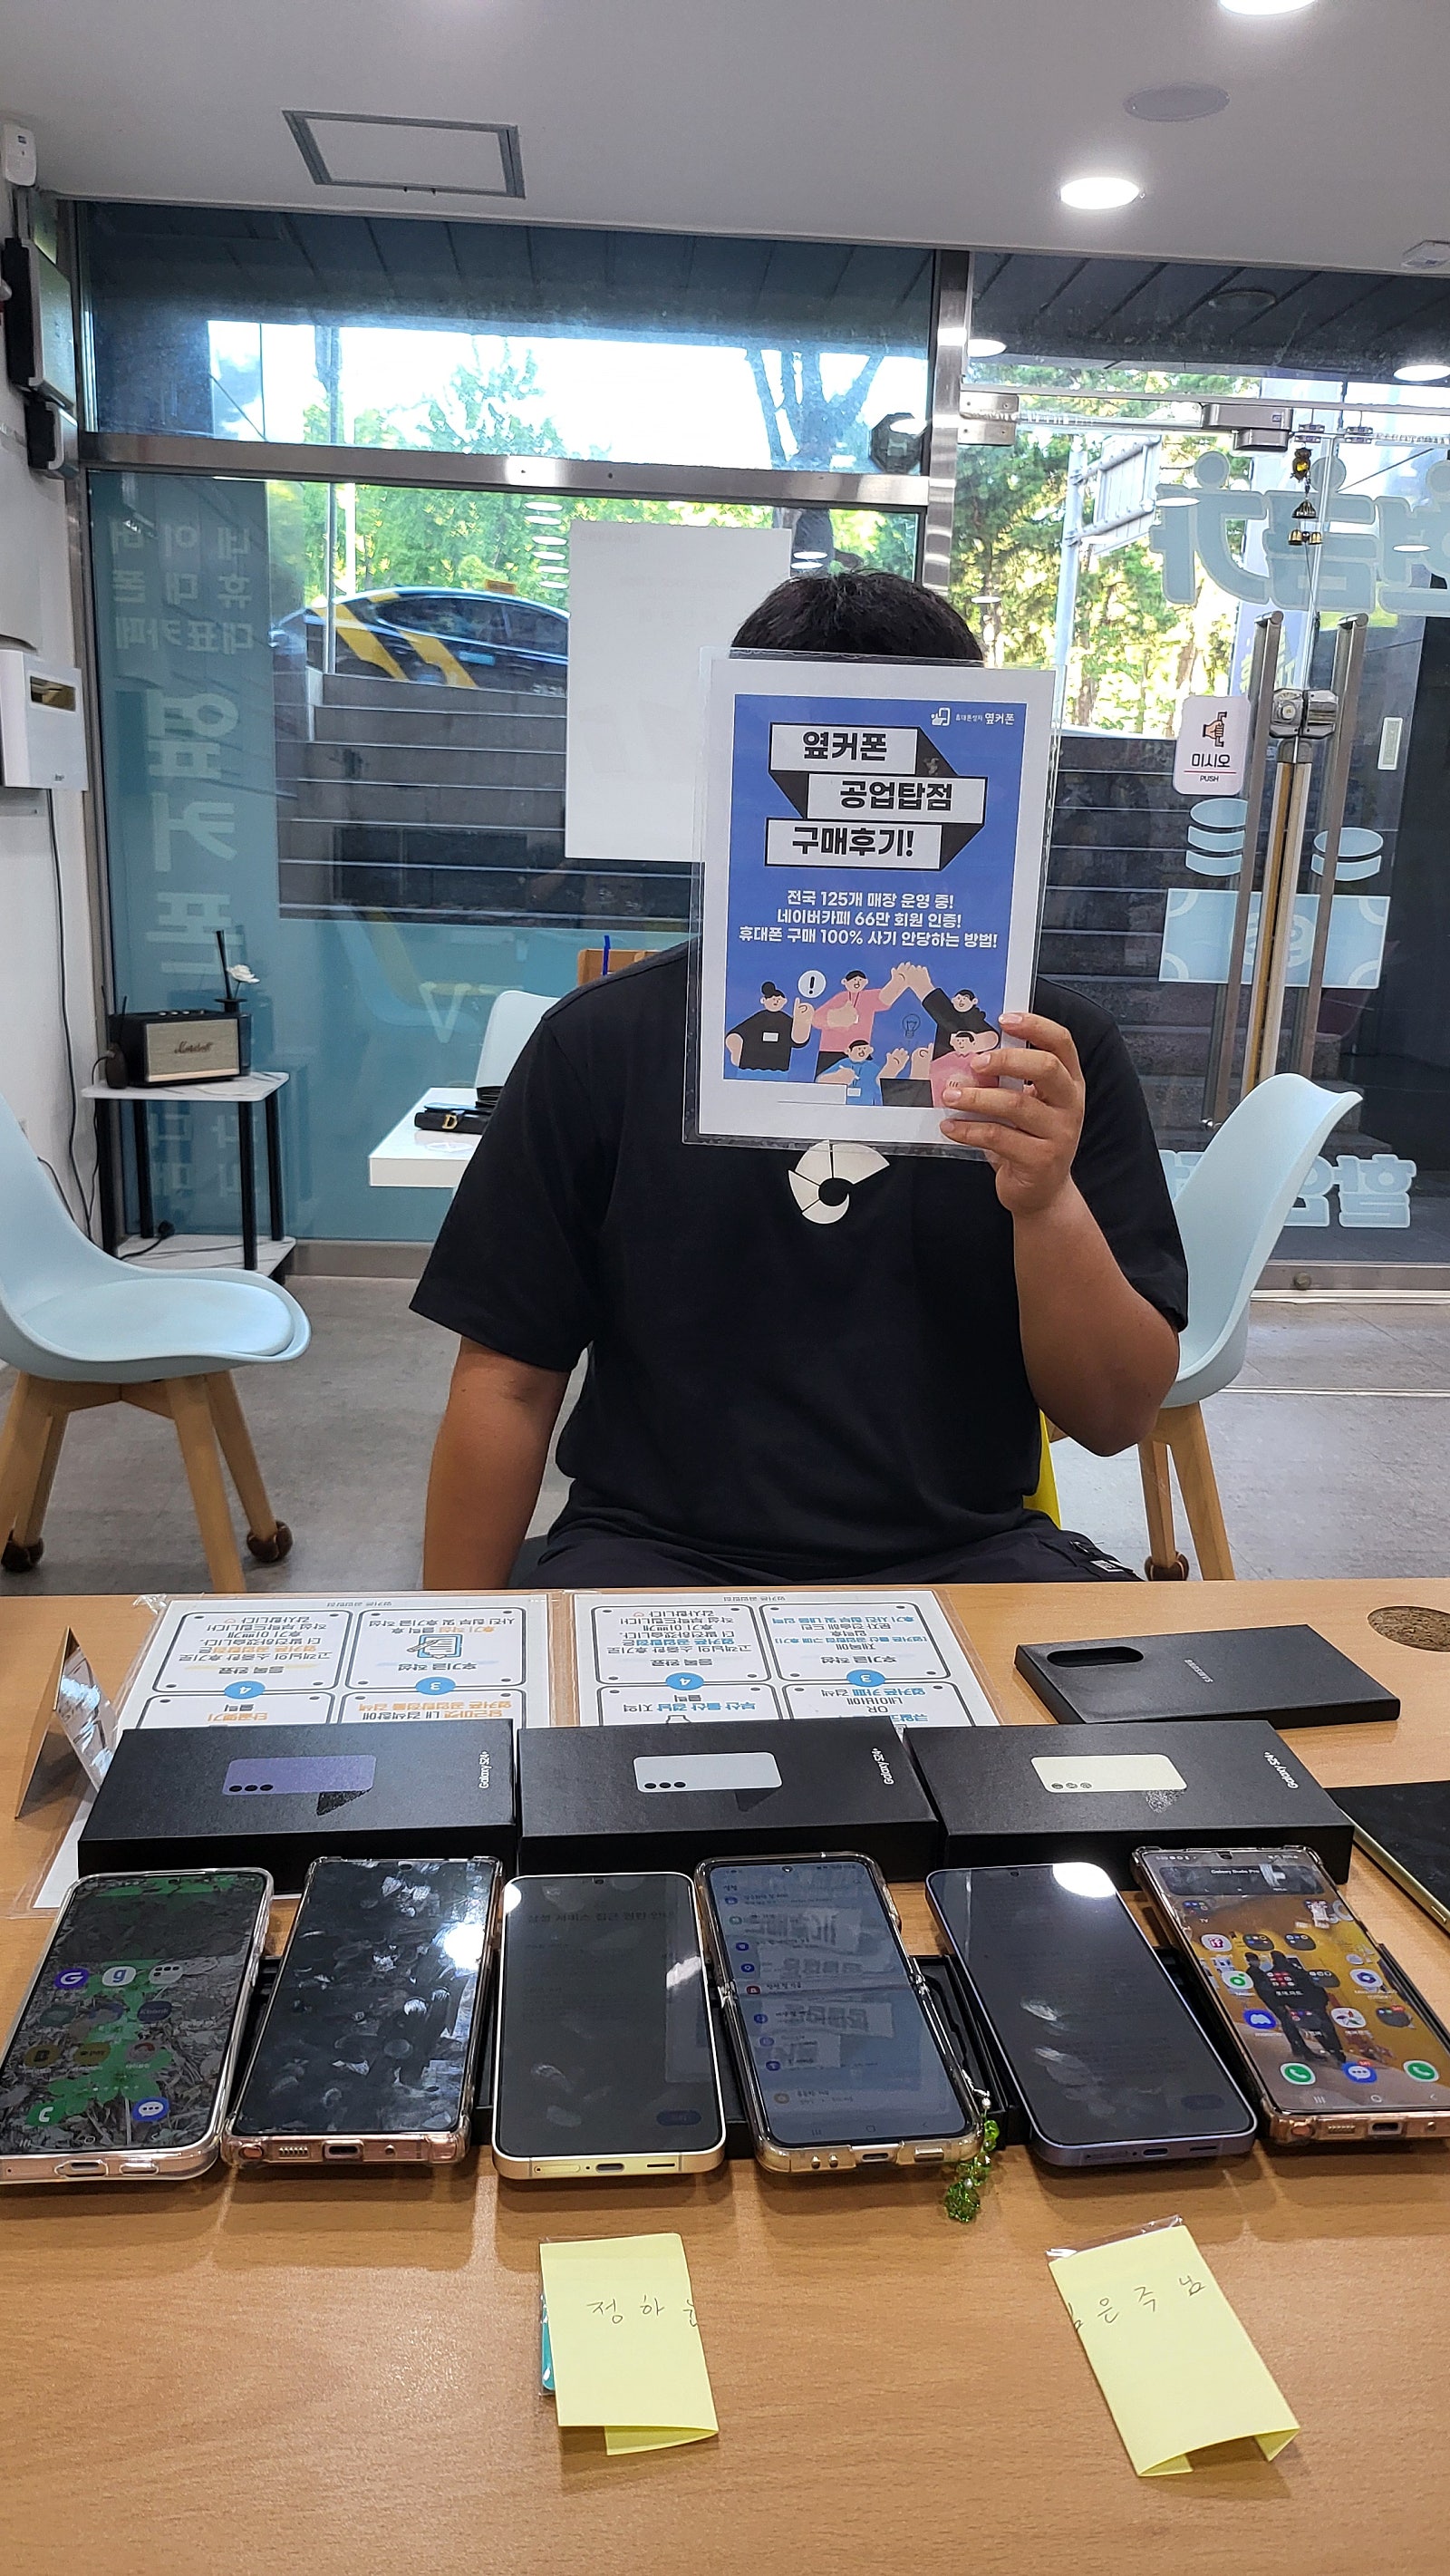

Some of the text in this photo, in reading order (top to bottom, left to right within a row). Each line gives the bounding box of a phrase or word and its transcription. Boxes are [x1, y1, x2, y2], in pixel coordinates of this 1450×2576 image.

[985, 712, 1014, 725] 옆커폰
[803, 731, 886, 761] 옆커폰
[1192, 753, 1230, 768] 미시오
[840, 780, 952, 811] 공업탑점
[792, 828, 914, 857] 구매후기!
[787, 891, 954, 910] 전국 125개 매장 운영 중!
[777, 910, 961, 930] 네이버카페 66만 회원 인증!
[739, 925, 998, 950] 휴대폰 구매 100% 사기 안당하는 방법!
[275, 1652, 332, 1661] 고객님의
[239, 1686, 252, 1694] 4
[363, 1711, 420, 1719] 검색창에
[624, 1704, 652, 1712] 지역
[658, 1703, 687, 1711] 경남
[726, 1702, 755, 1710] 부산
[479, 1750, 492, 1788] Galaxy S24+
[871, 1748, 894, 1785] Galaxy S24+
[1264, 1751, 1298, 1788] Galaxy S24+
